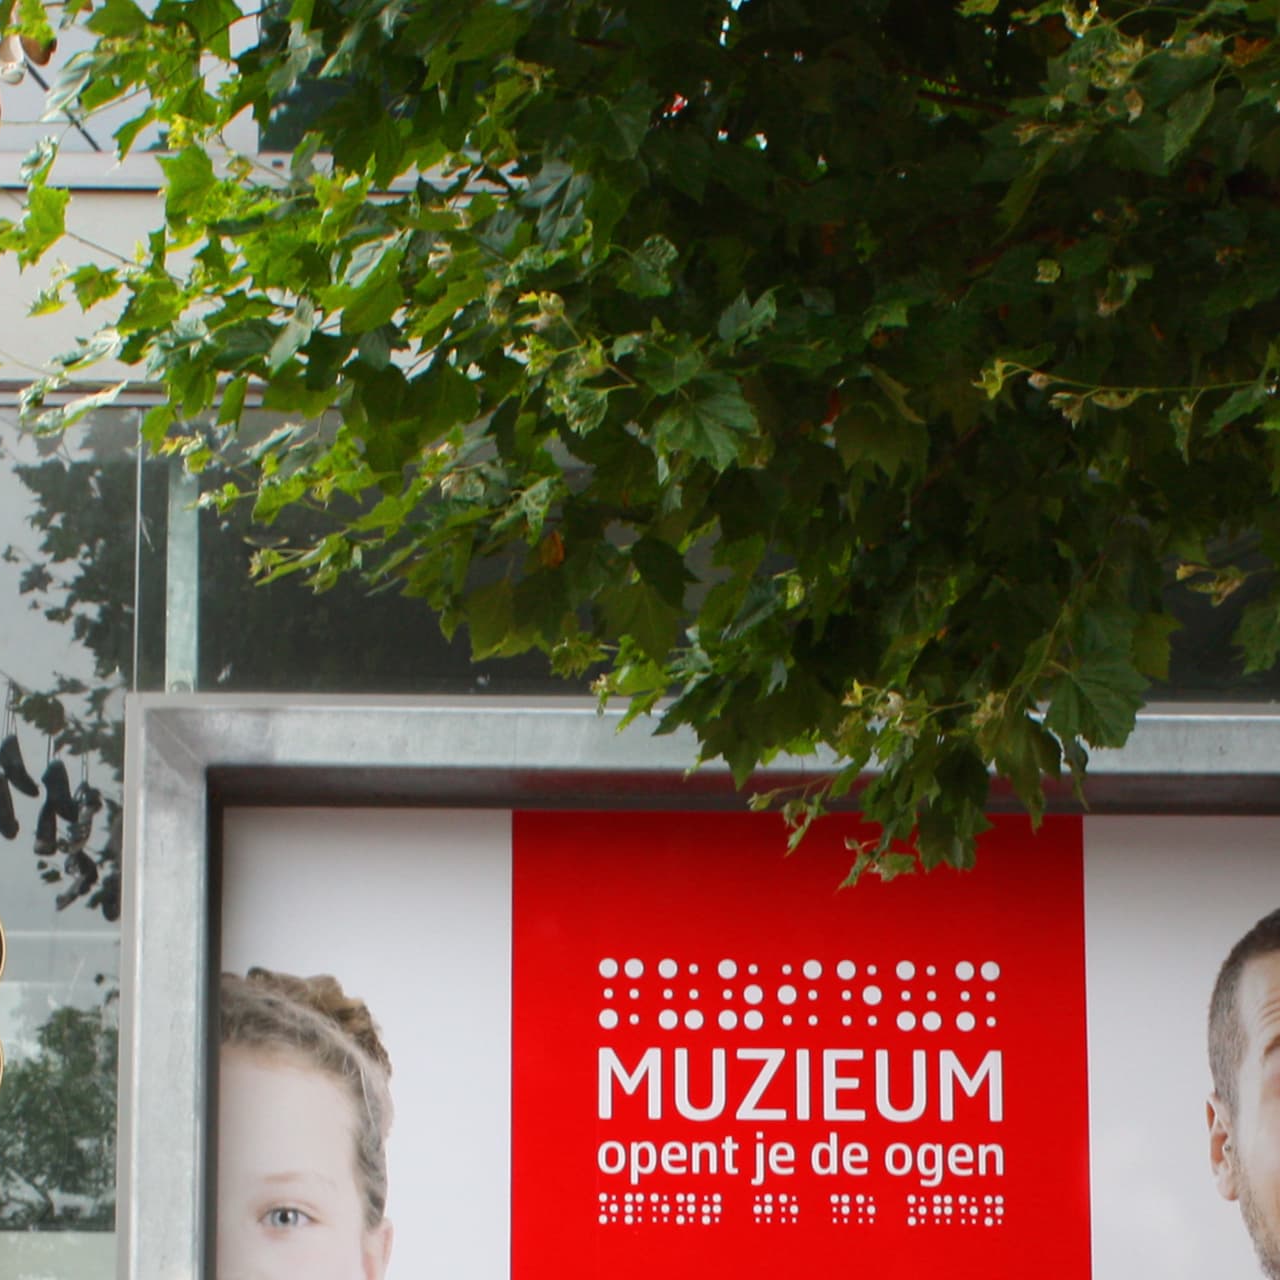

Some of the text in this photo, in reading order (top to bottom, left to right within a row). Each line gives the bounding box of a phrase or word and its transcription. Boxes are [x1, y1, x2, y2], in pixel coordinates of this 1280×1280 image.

[598, 1046, 1003, 1123] MUZIEUM
[597, 1131, 1005, 1187] opent je de ogen
